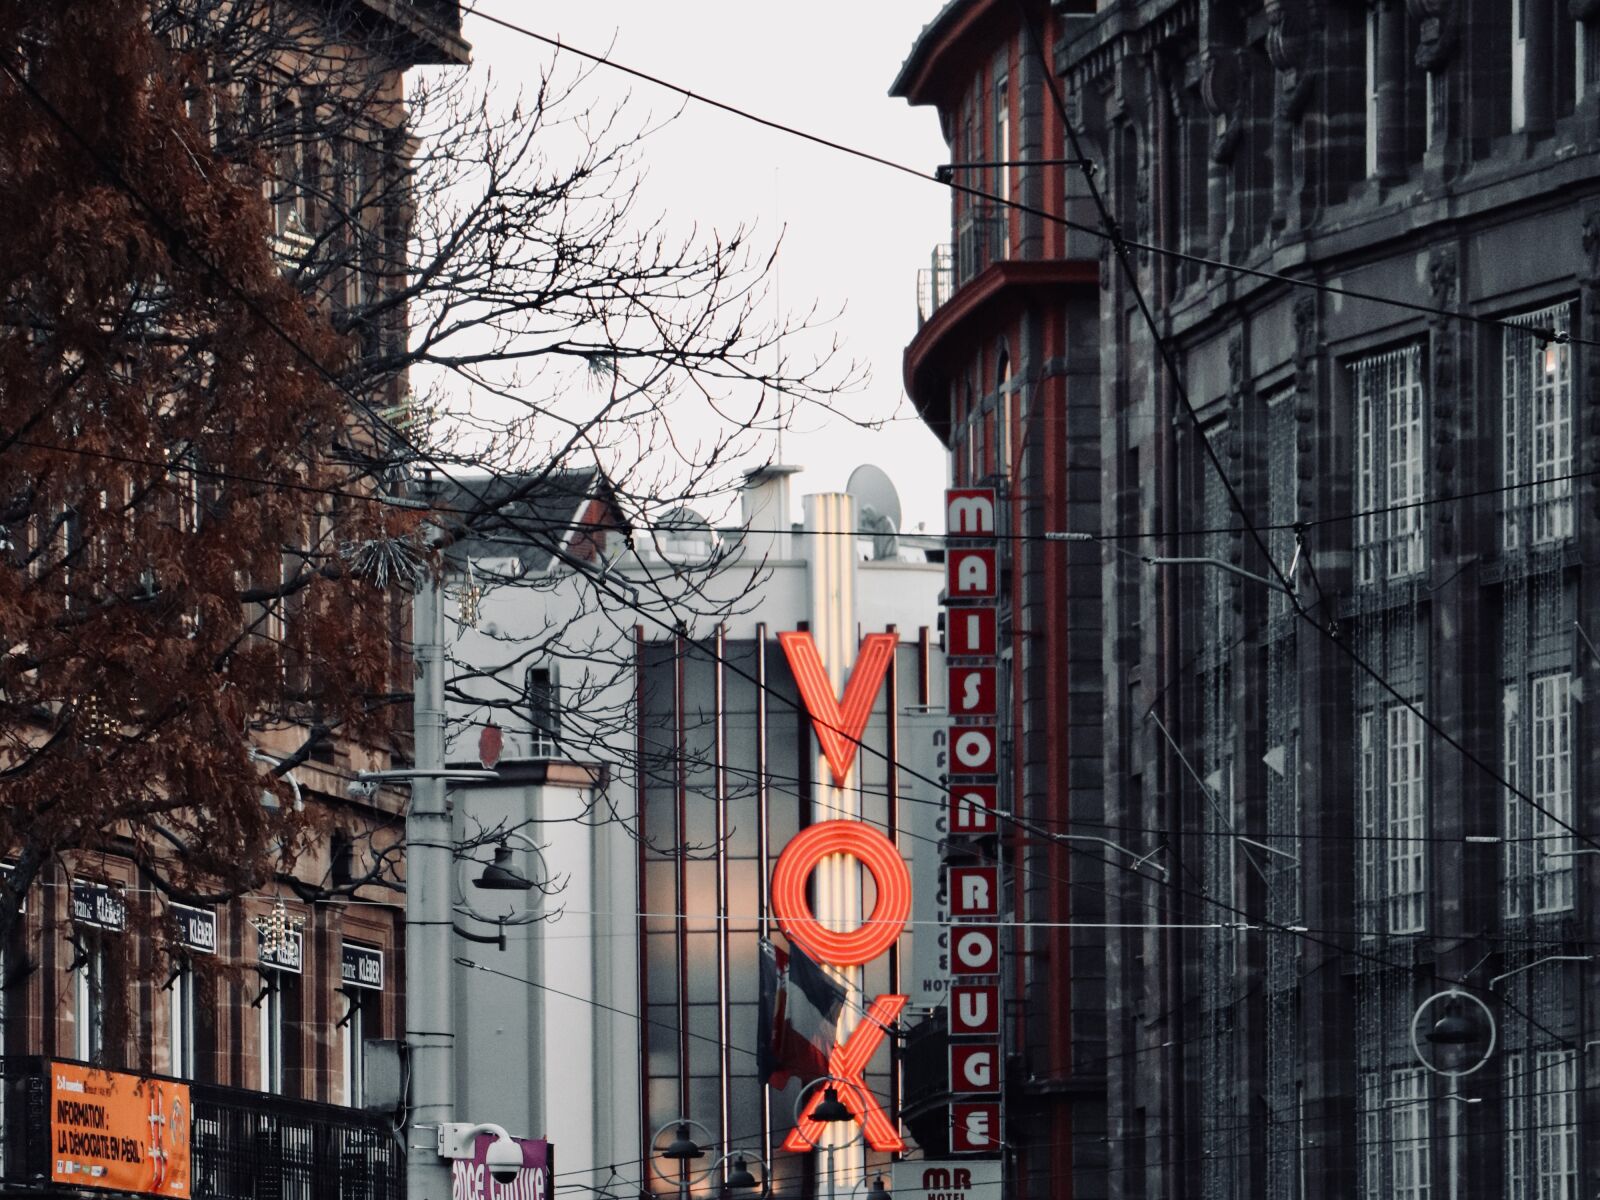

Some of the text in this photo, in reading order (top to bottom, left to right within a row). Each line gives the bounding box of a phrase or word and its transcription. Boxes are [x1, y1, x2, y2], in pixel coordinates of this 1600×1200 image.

[949, 496, 993, 1146] MAISON ROUGE
[775, 631, 912, 1152] VOX
[57, 1099, 105, 1129] INFORMATION
[57, 1129, 68, 1154] LA
[110, 1136, 120, 1161] EN
[923, 1167, 972, 1190] MR
